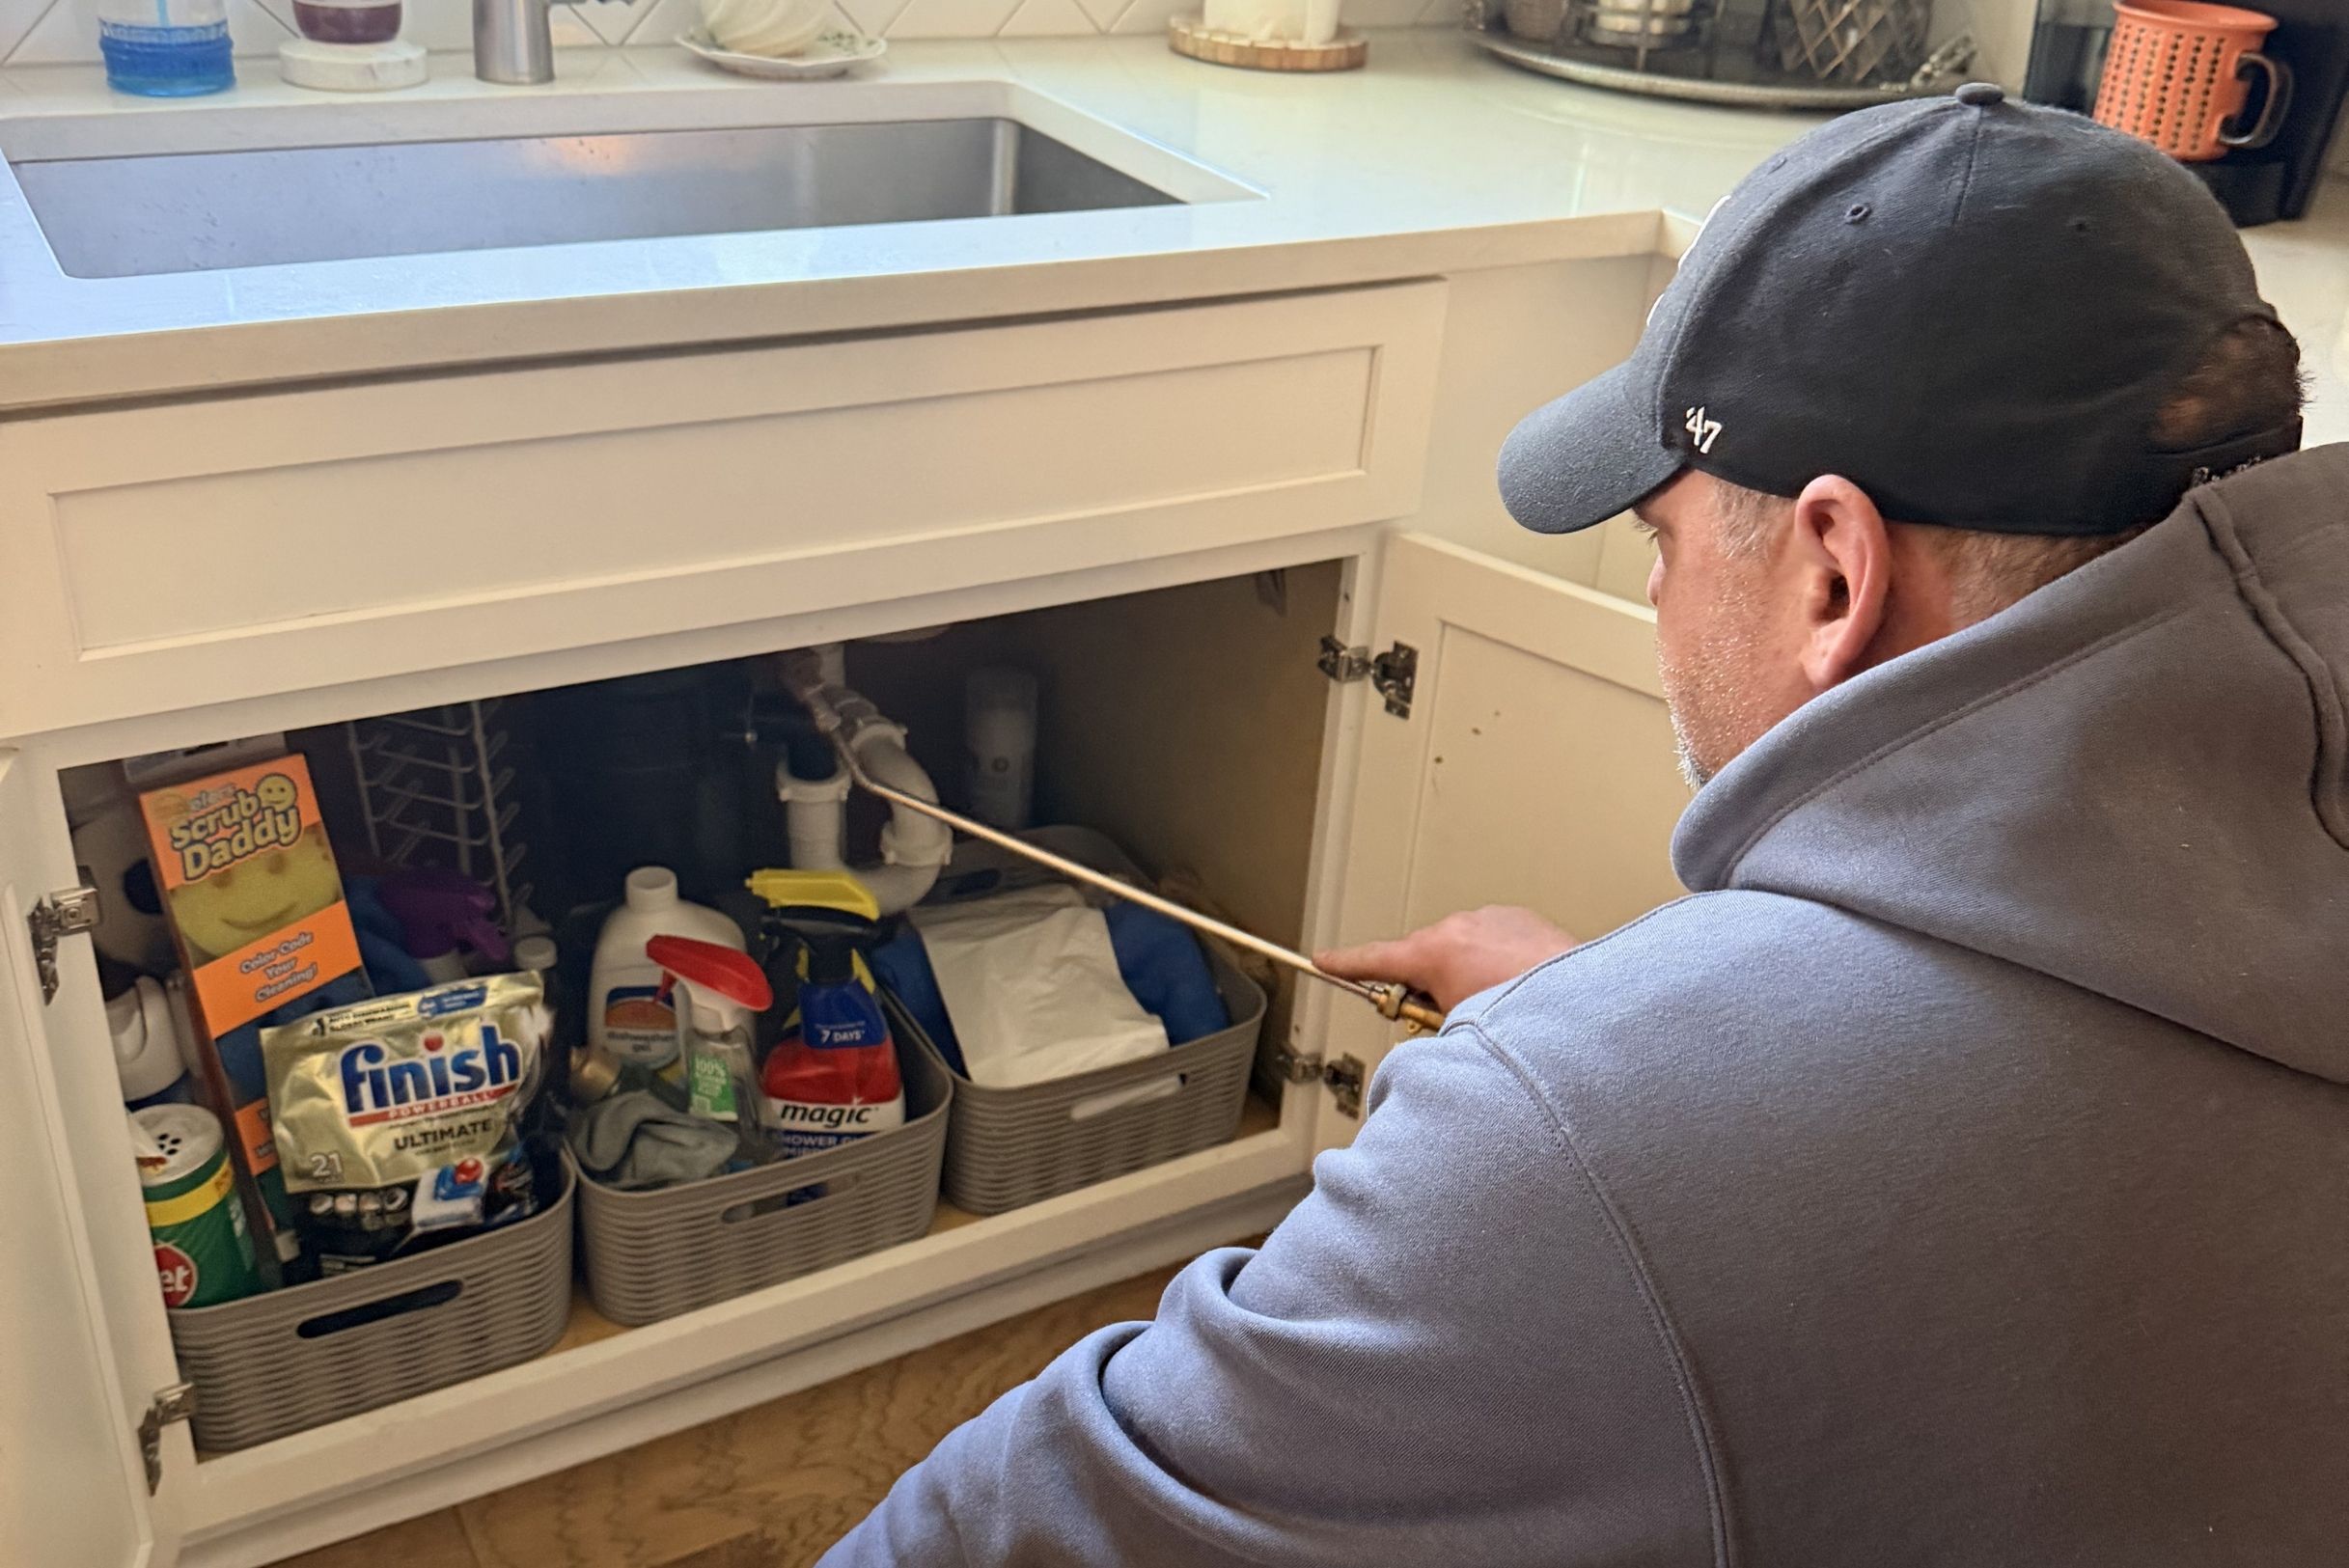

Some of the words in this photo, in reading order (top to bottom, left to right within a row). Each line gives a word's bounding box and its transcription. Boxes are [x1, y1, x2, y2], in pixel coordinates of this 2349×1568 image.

[182, 806, 301, 881] Daddy
[239, 949, 278, 975] Color
[278, 931, 314, 956] Code
[820, 1029, 831, 1044] 7
[341, 1025, 521, 1114] finish
[388, 1091, 496, 1119] POWERBALL
[781, 1098, 871, 1128] magic
[394, 1118, 494, 1150] ULTIMATE
[311, 1150, 343, 1177] 21
